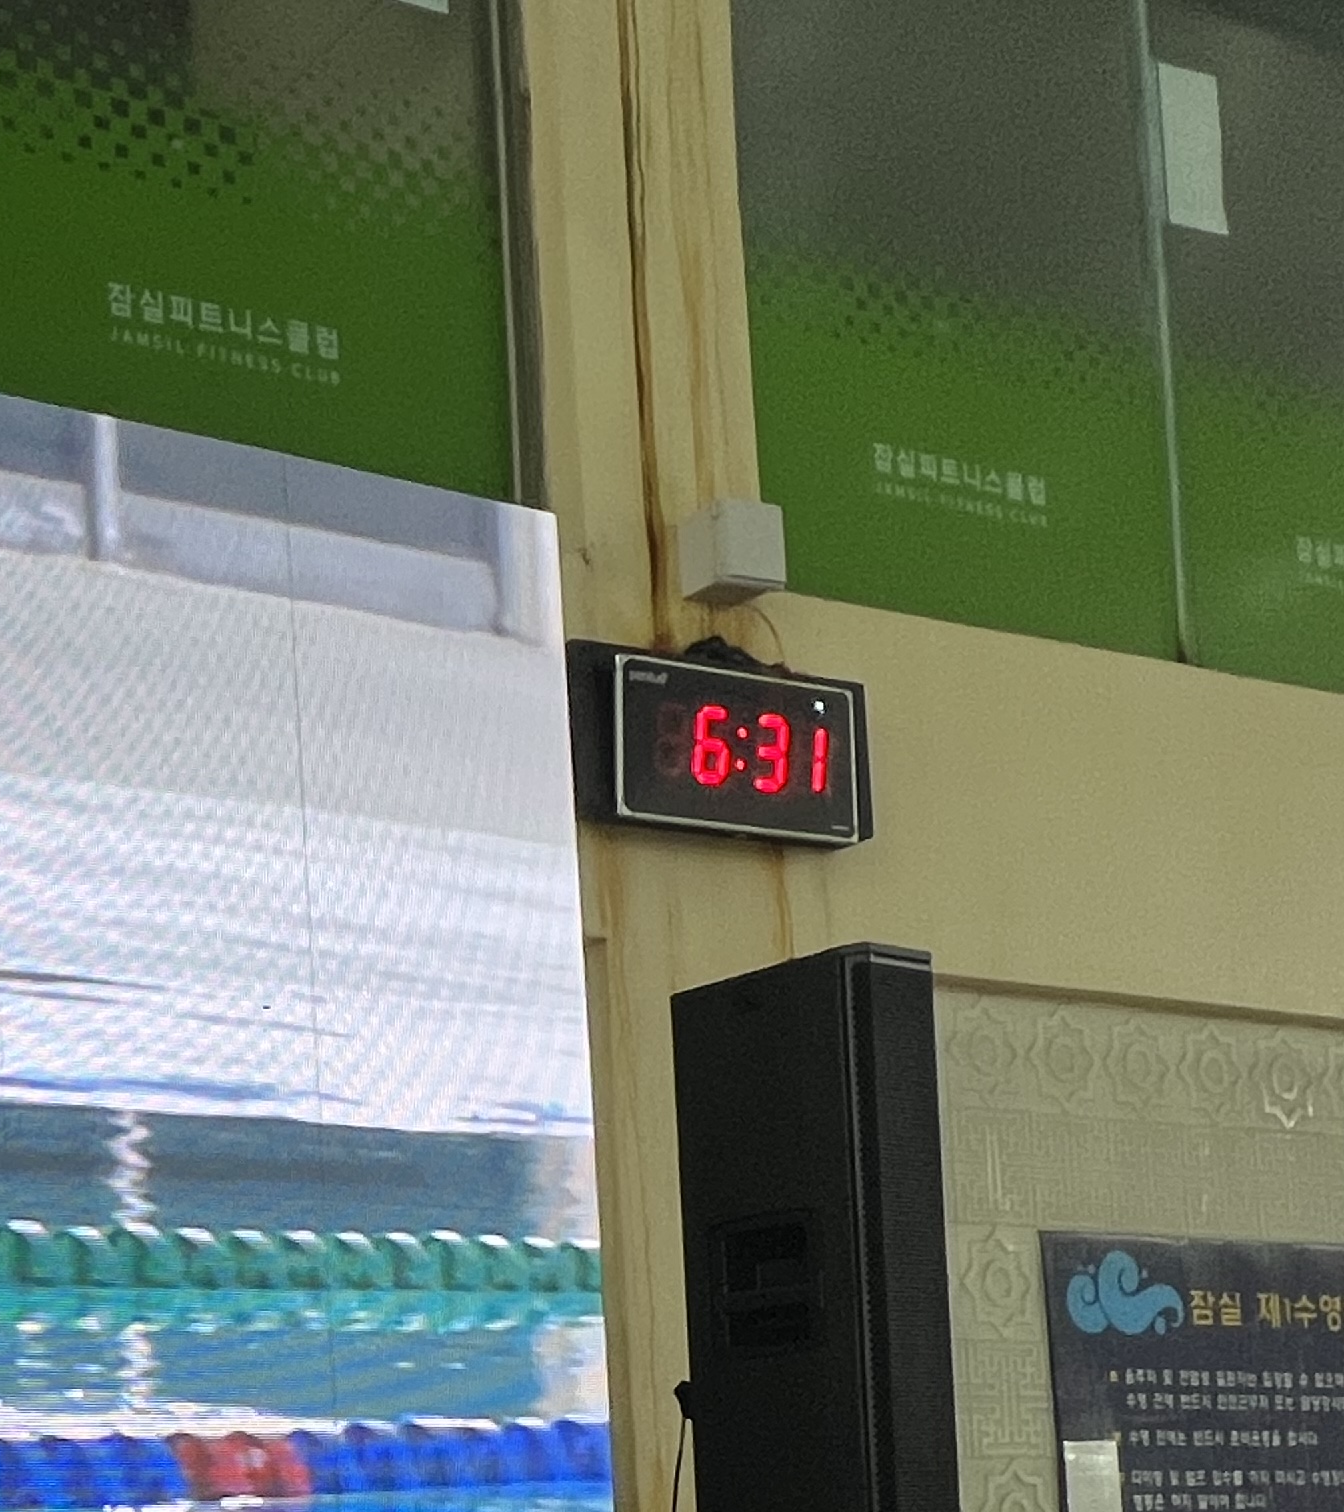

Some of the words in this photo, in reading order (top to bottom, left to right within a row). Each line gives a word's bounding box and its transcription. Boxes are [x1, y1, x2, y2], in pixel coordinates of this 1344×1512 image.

[108, 282, 339, 360] 잠실피트니스클럽
[690, 704, 830, 794] 6:31
[1190, 1290, 1243, 1327] 잠실
[1257, 1292, 1343, 1332] 제1수영
